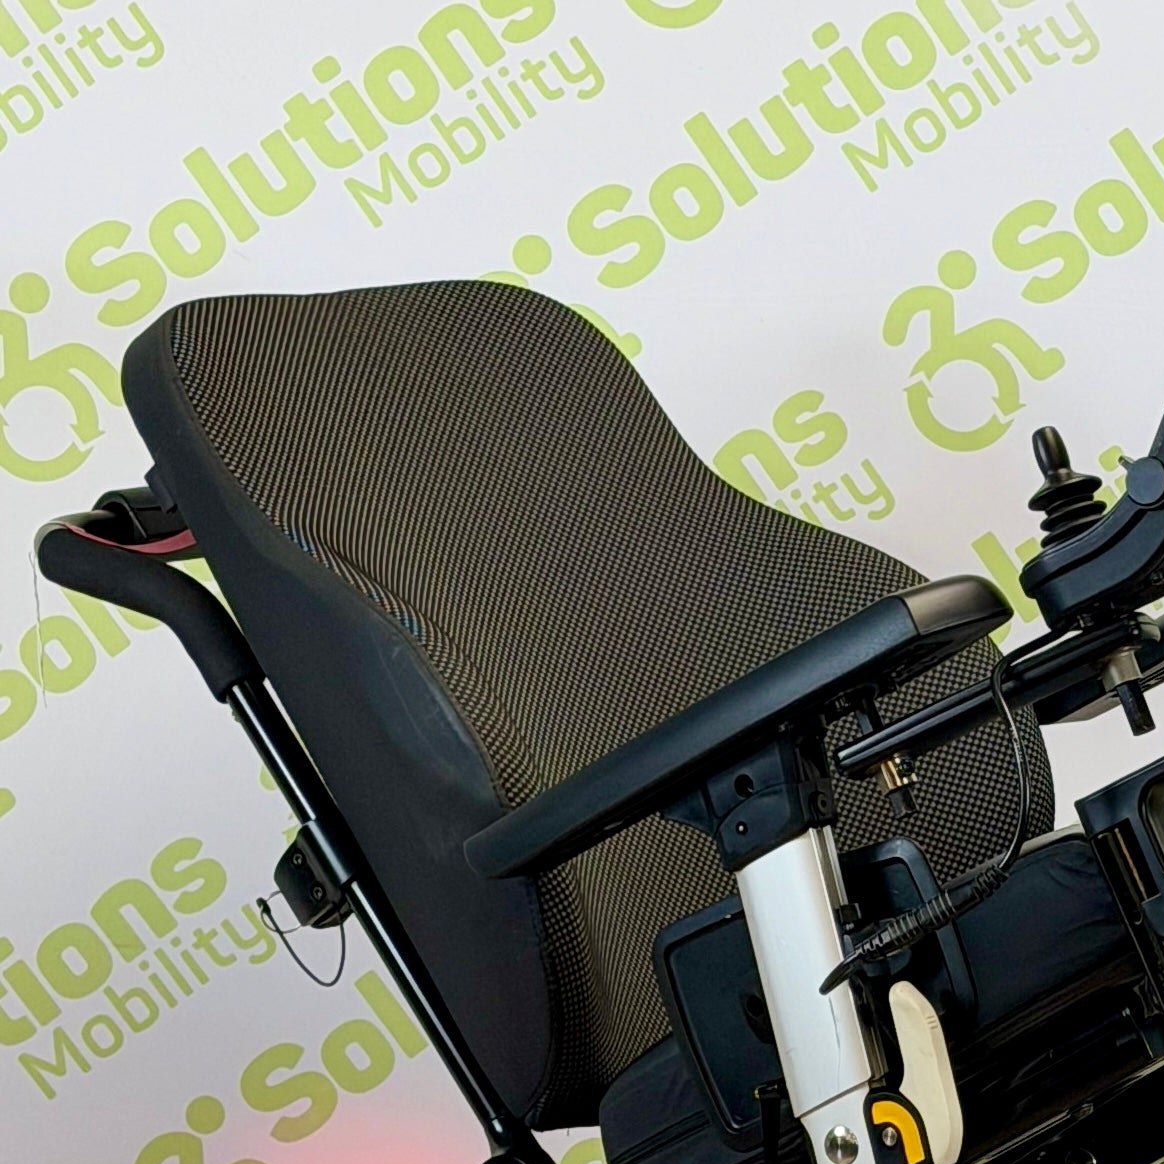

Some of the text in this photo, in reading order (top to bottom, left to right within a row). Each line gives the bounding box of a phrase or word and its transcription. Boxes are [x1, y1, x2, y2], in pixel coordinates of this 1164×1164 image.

[0, 3, 165, 150] bility
[343, 36, 605, 228] Mobility
[566, 0, 1035, 289] Solution
[841, 11, 1098, 192] Mobility
[17, 905, 276, 1100] Mobility
